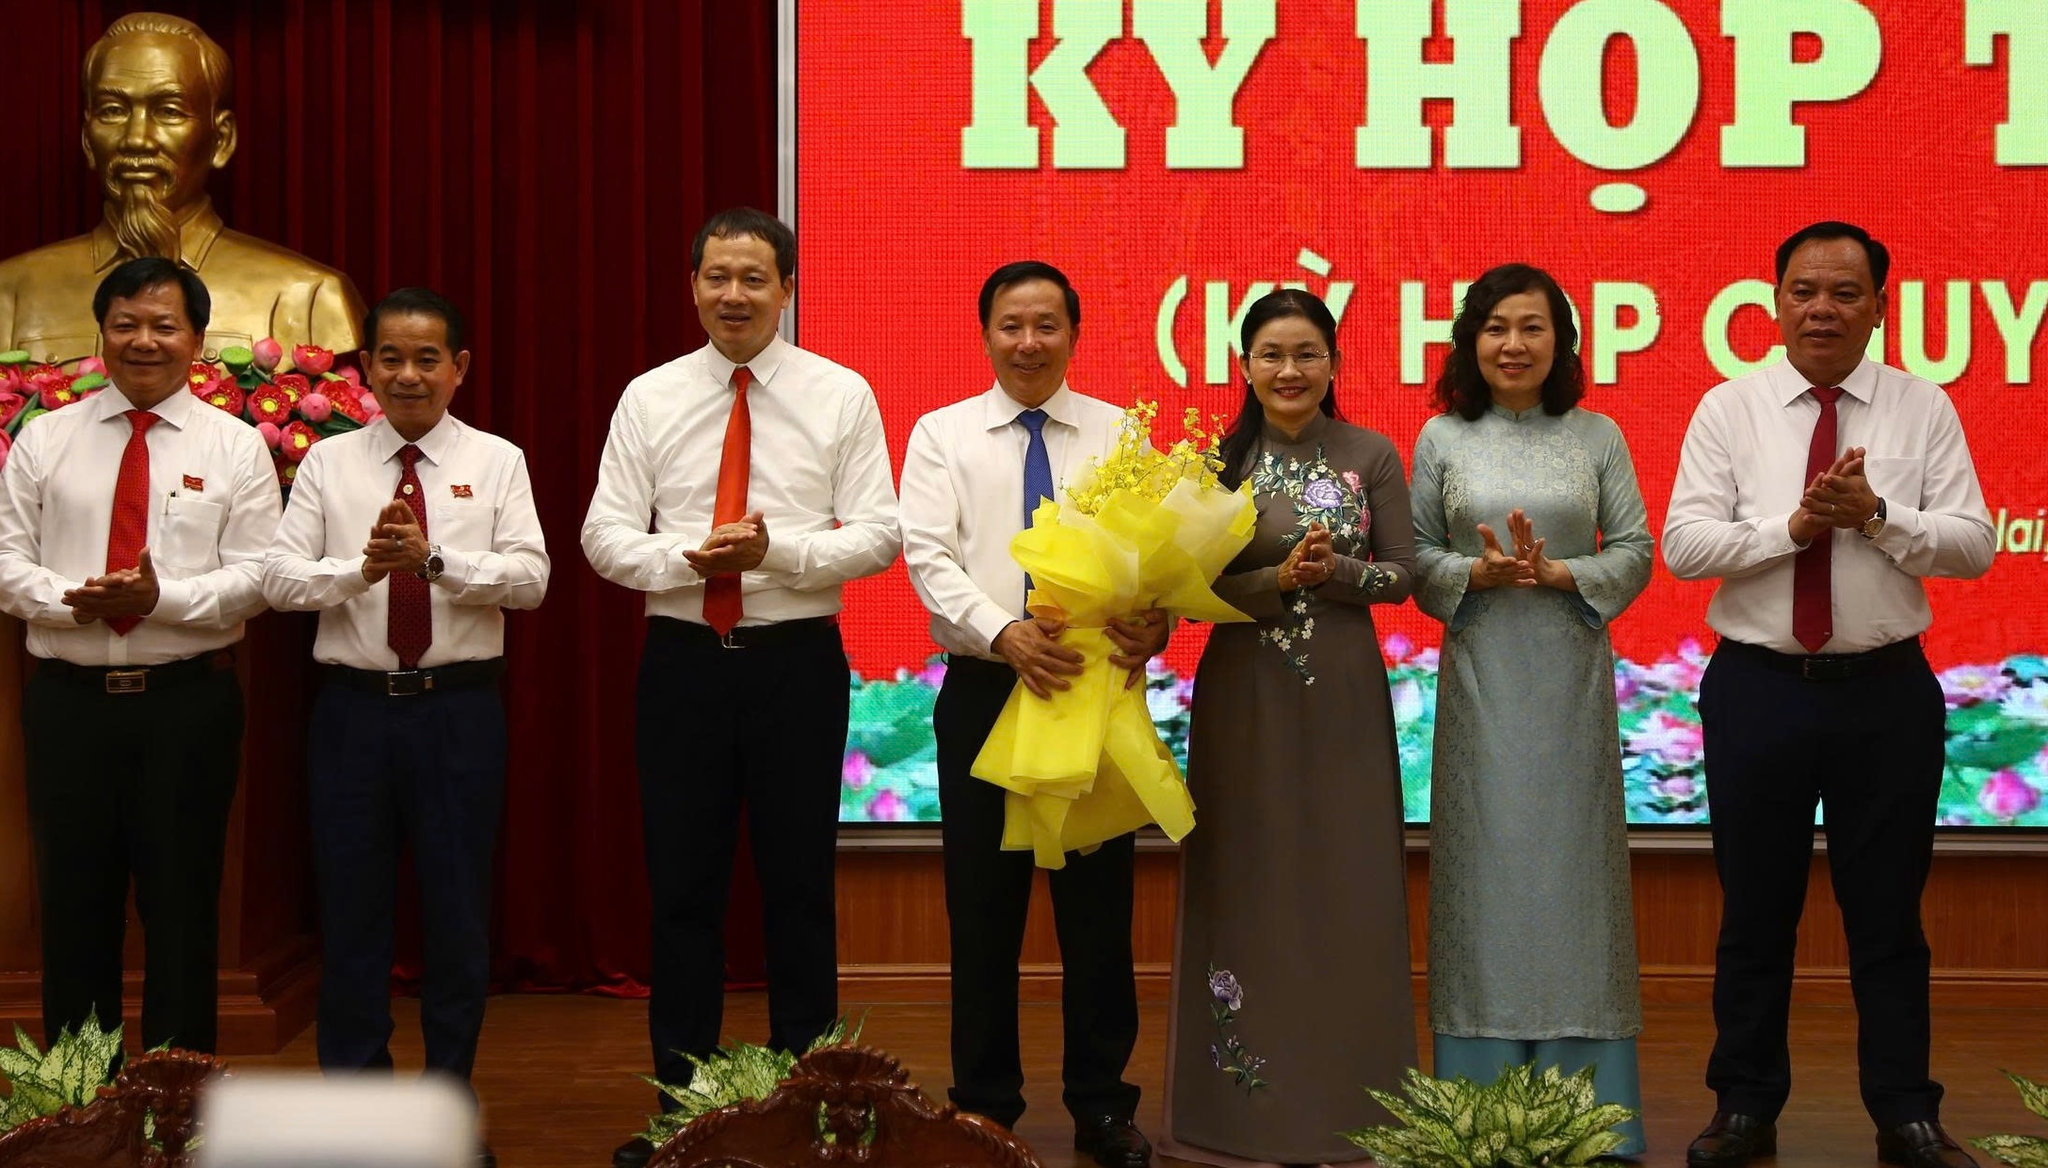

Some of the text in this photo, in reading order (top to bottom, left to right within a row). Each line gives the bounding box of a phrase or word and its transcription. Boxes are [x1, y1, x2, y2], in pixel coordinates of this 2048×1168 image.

[1356, 0, 1882, 212] HỌP
[1400, 281, 1661, 384] HP
[1702, 279, 2048, 385] CUY
